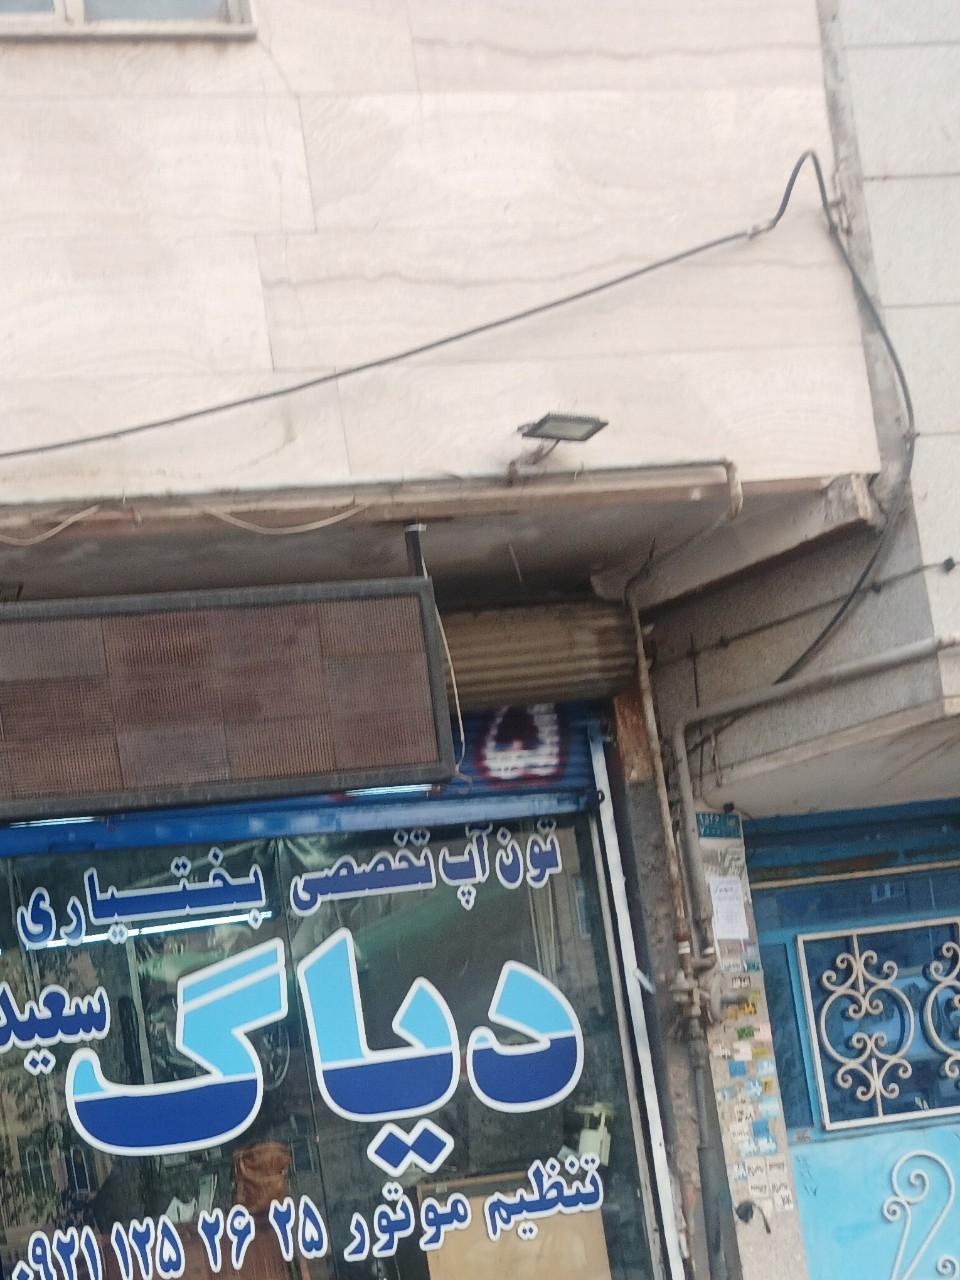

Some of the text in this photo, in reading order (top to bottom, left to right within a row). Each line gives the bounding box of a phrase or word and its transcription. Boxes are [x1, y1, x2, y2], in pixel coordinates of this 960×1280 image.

[16, 846, 266, 949] بختیاری
[290, 828, 437, 917] تخصصی
[439, 822, 493, 911] آپ
[65, 928, 585, 1177] دیاگ
[197, 1203, 256, 1274] ۲۶
[267, 1193, 328, 1262] ۲۵
[344, 1181, 472, 1262] موتور
[484, 1152, 603, 1241] تنظیم
